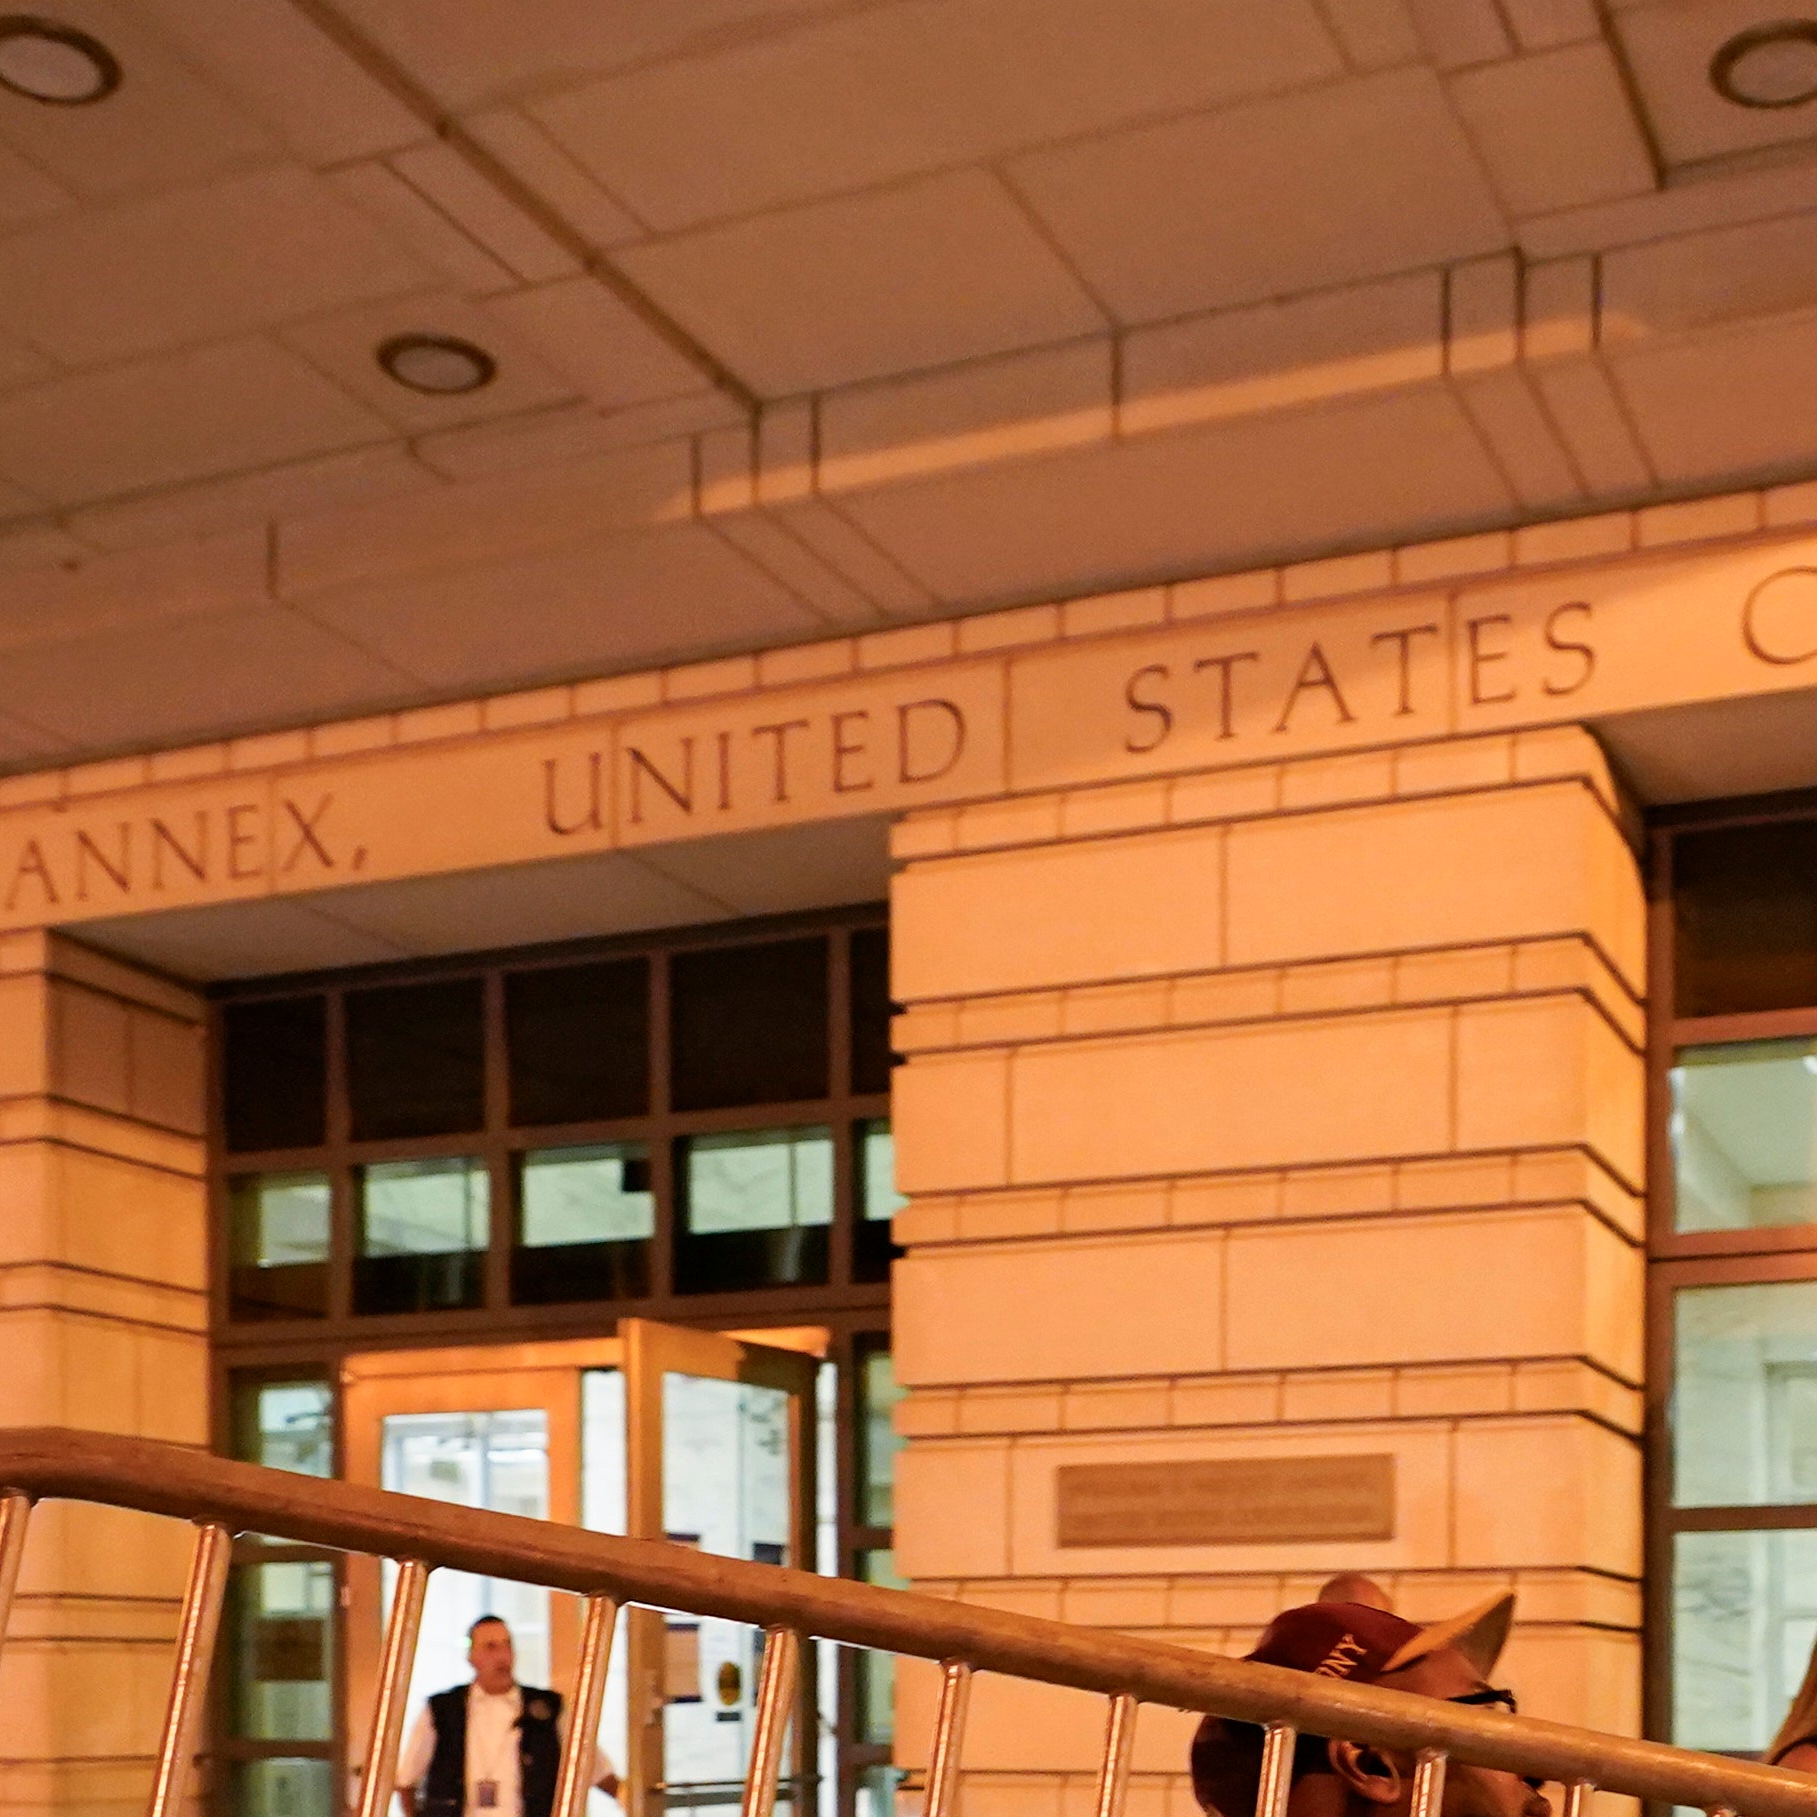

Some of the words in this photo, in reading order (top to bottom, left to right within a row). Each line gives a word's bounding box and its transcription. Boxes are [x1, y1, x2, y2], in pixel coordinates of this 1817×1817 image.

[3, 793, 369, 912] ANNEX,
[542, 698, 968, 836] UNITED
[1123, 600, 1597, 754] STATES
